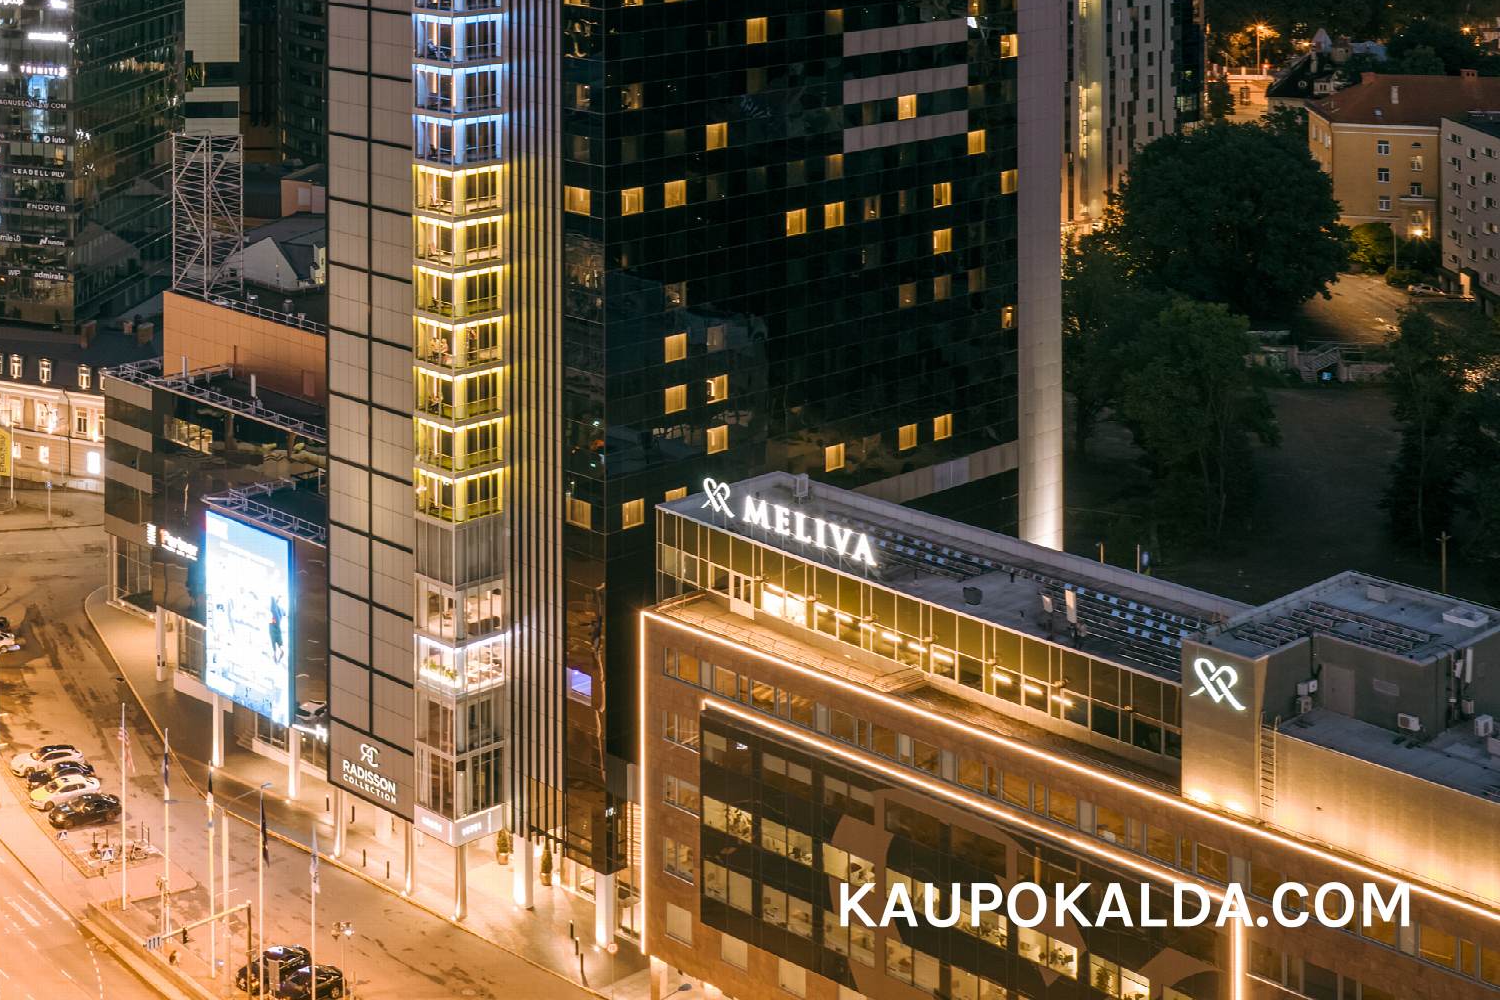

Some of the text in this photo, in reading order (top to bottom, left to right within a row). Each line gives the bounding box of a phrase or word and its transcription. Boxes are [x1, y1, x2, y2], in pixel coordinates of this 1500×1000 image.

[51, 135, 66, 144] iute
[12, 168, 49, 178] LEADELL
[26, 202, 66, 213] ENDOVER
[34, 272, 65, 281] admirals
[742, 495, 877, 566] MELIVA
[342, 759, 396, 793] RADISSON
[343, 773, 397, 805] COLLECTION
